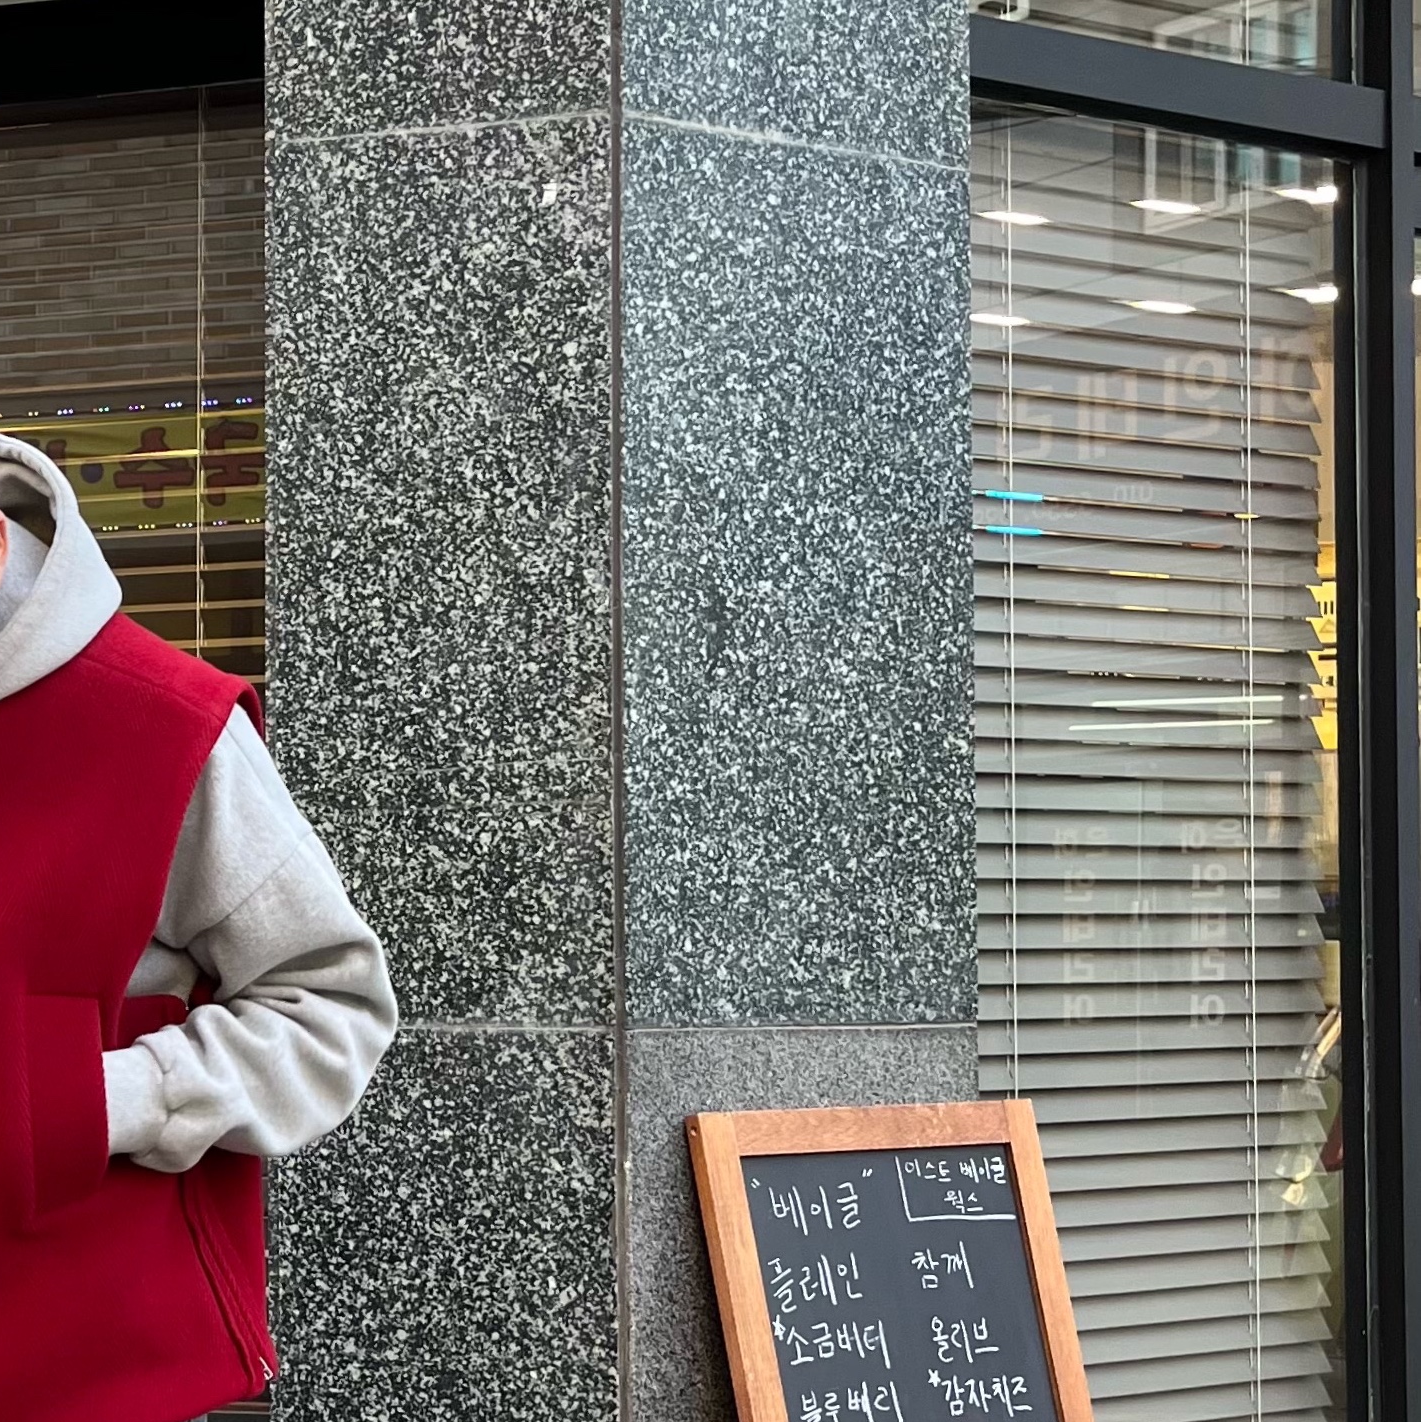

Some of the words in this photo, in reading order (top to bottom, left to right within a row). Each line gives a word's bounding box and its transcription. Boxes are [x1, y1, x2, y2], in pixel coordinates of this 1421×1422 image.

[904, 1158, 952, 1182] 이스트
[959, 1156, 1007, 1184] 베이글
[943, 1189, 984, 1214] 웍스
[767, 1251, 863, 1313] 플레인
[912, 1241, 975, 1289] 참깨
[786, 1318, 891, 1370] 소금버터
[931, 1316, 1000, 1364] 올리브
[941, 1375, 1033, 1418] 감자치즈
